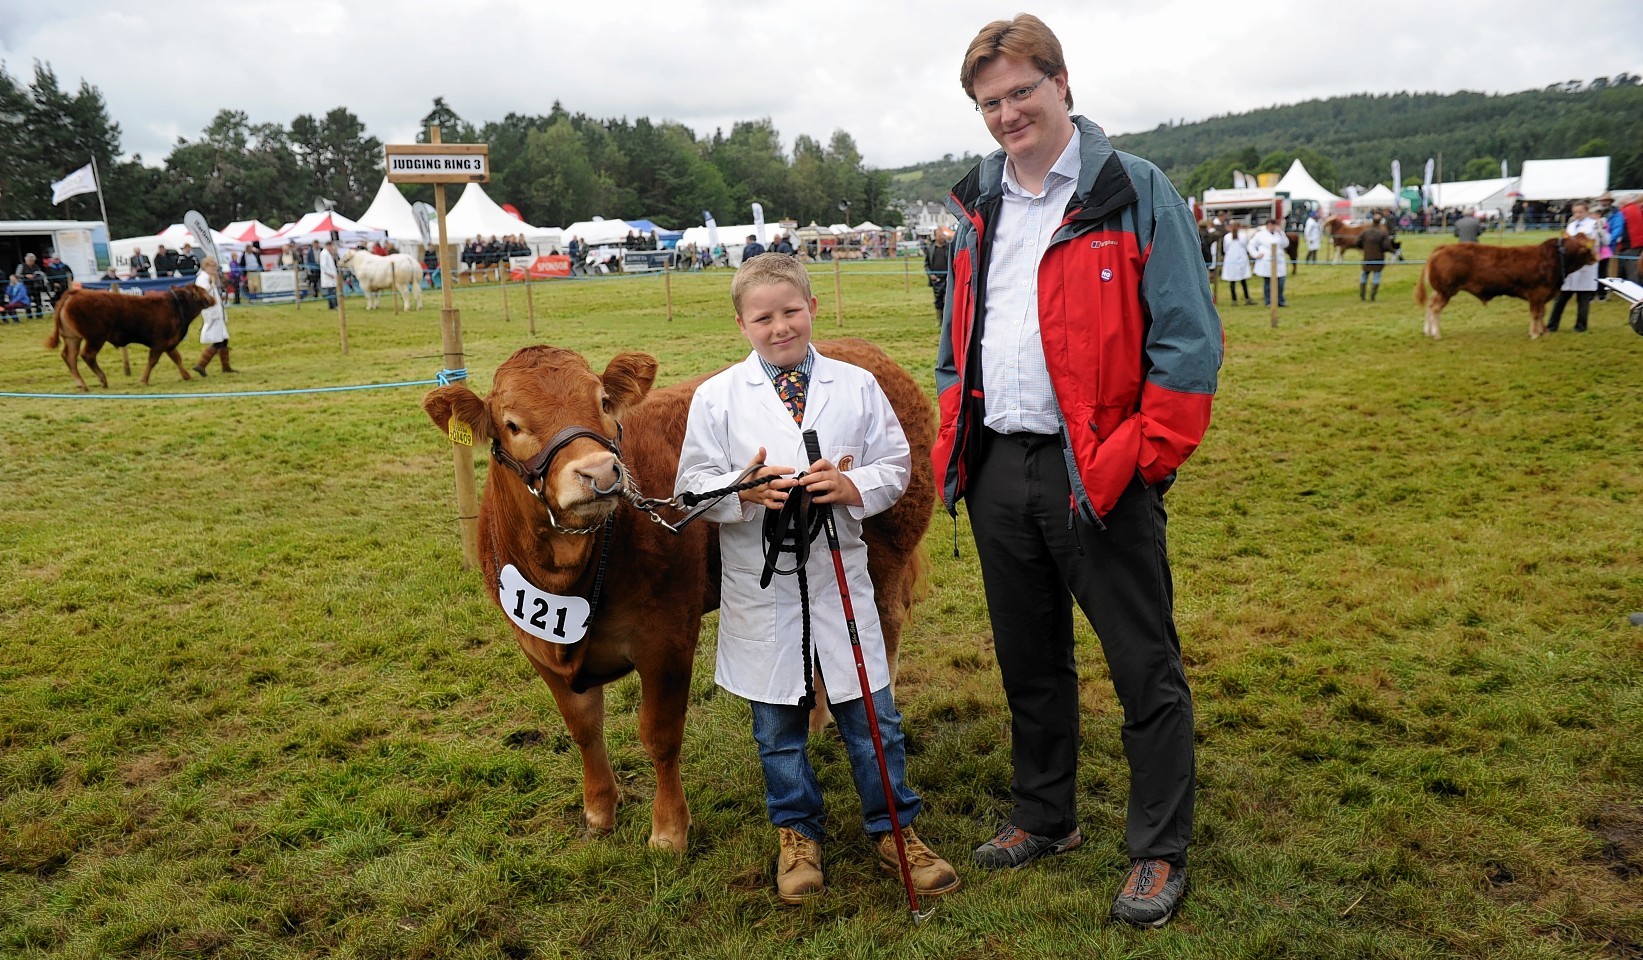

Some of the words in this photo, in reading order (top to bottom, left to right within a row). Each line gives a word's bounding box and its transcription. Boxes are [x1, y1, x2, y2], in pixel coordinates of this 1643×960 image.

[393, 159, 441, 170] JUDGING
[445, 159, 471, 170] RING
[474, 159, 481, 170] 3
[537, 261, 569, 272] SPONSOR
[513, 589, 568, 638] 121
